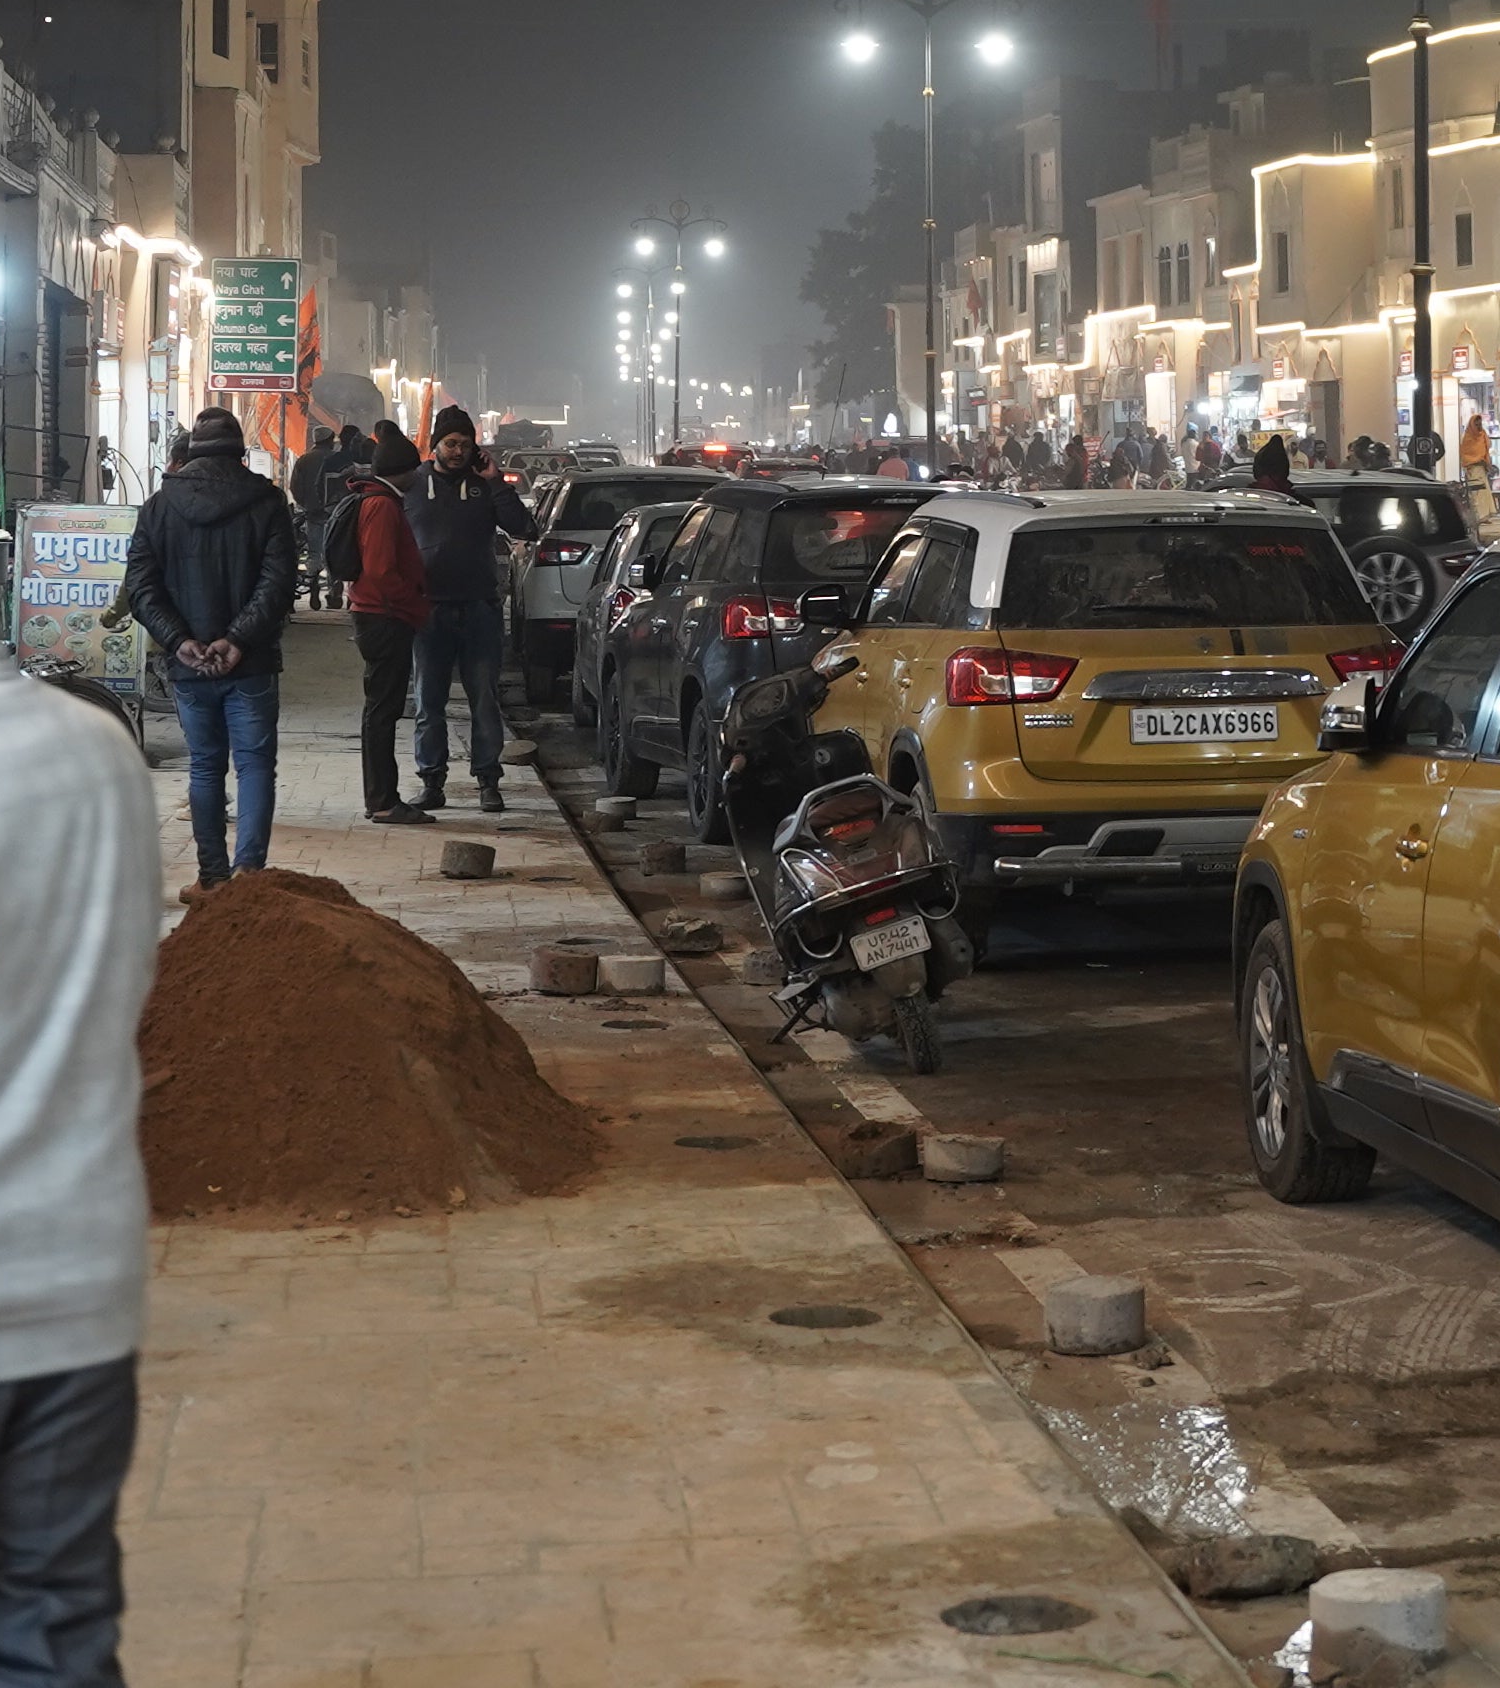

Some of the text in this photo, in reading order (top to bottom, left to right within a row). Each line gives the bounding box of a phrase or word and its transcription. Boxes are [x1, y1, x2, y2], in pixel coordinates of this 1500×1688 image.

[216, 267, 259, 277] नया घाट
[215, 285, 264, 296] Naya Ghat
[213, 342, 268, 354] दशरथ महल
[213, 360, 274, 371] Dashrath Mahal
[22, 570, 121, 606] भोजनाल
[1146, 710, 1275, 738] DL2CAX6966
